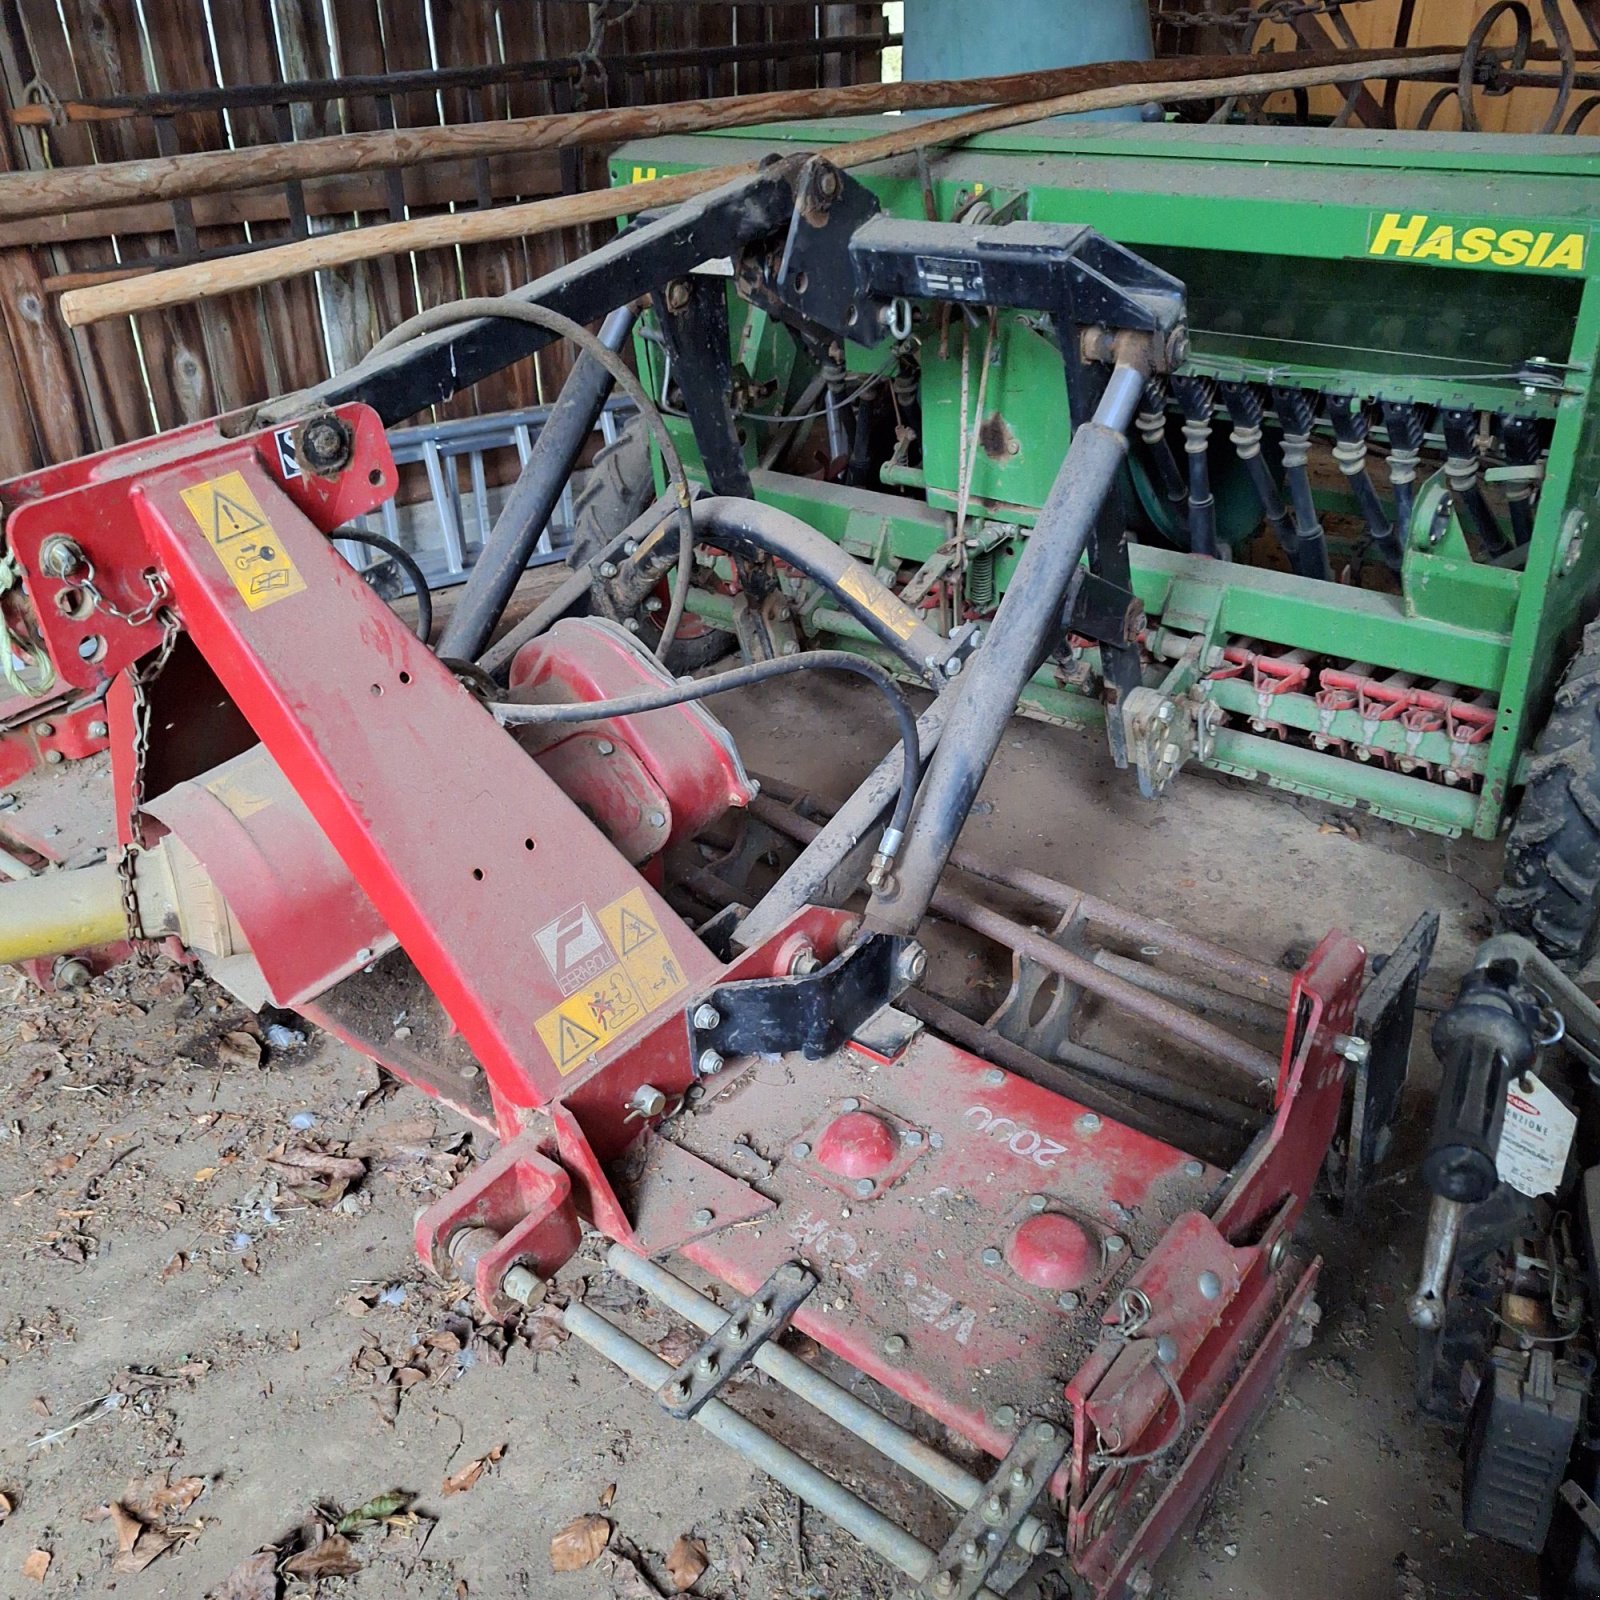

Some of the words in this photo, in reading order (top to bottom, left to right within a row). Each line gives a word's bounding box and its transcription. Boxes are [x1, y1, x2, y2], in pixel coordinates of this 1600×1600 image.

[1369, 213, 1585, 270] HASSIA
[558, 947, 614, 993] FERABOLI
[787, 1209, 977, 1345] VETOR
